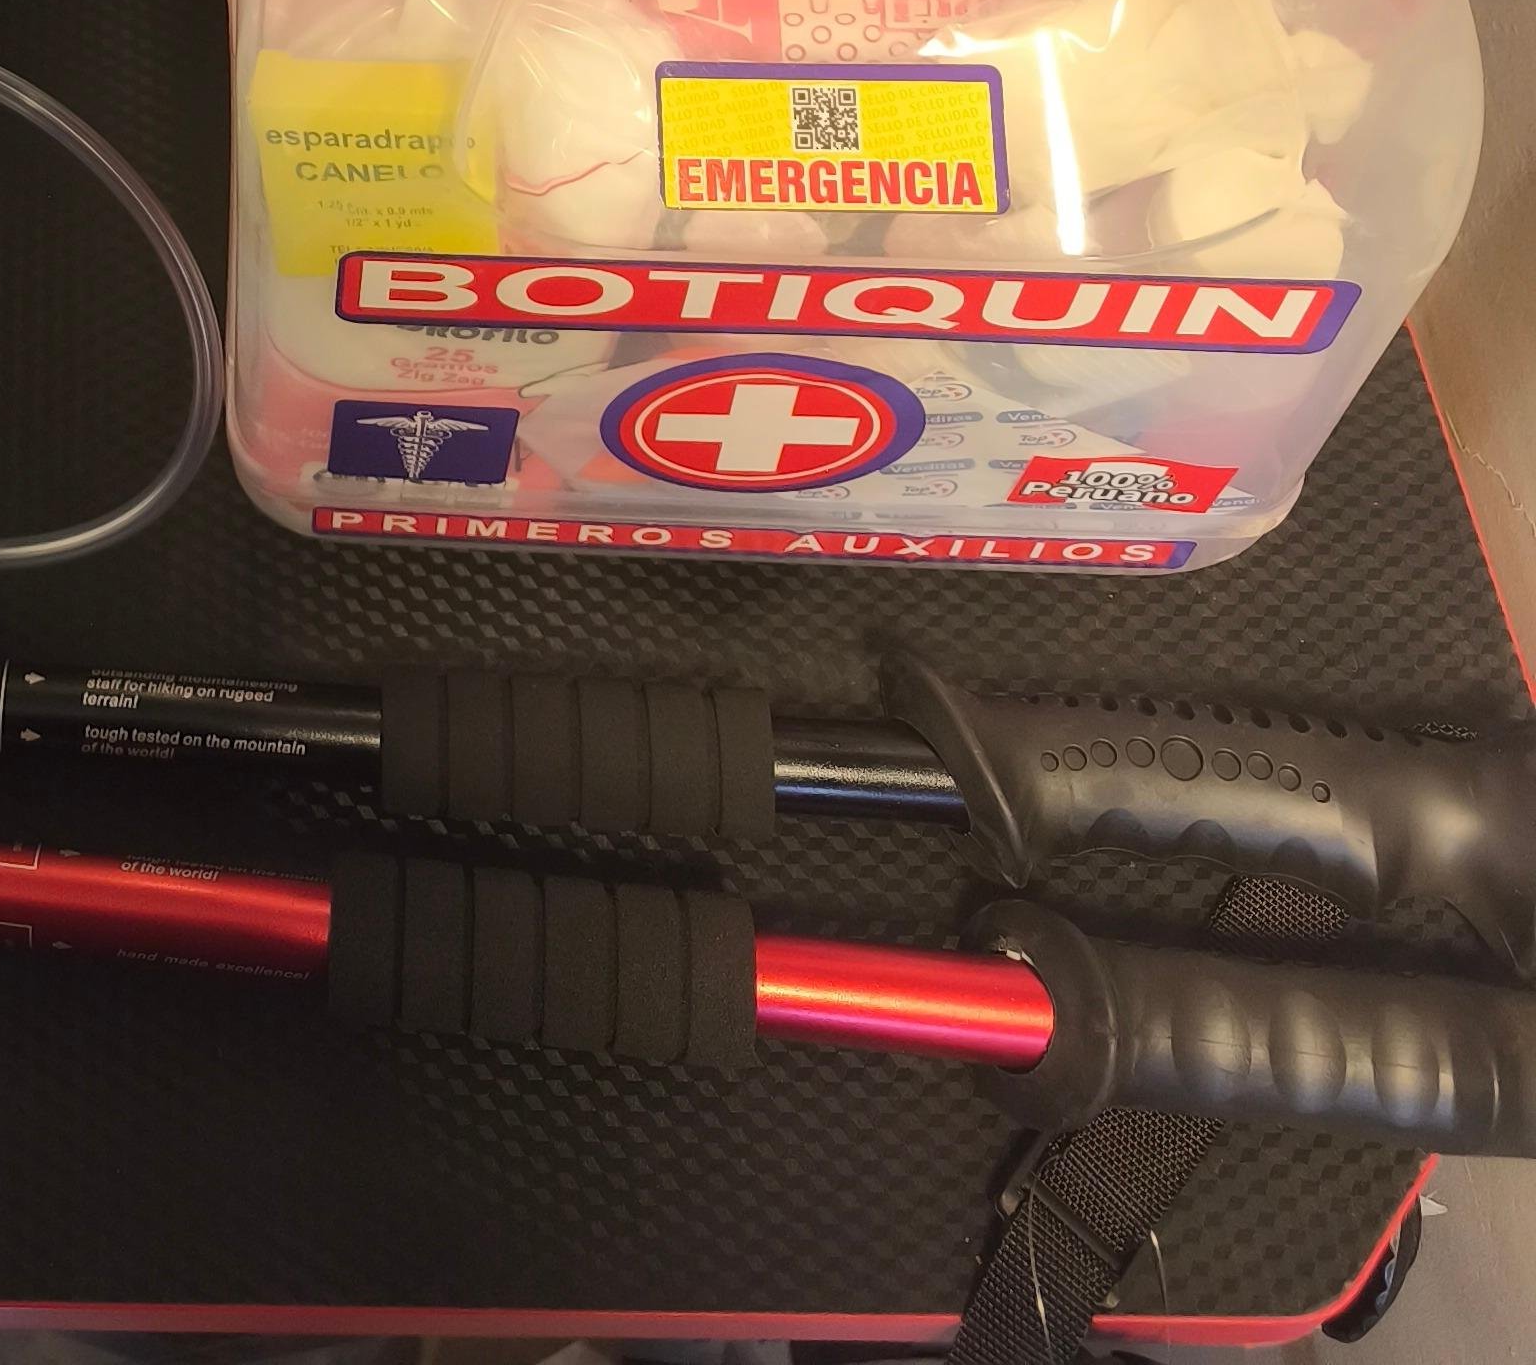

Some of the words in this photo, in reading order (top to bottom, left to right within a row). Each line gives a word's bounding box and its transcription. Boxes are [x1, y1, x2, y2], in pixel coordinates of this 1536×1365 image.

[677, 157, 983, 206] EMERGENCIA
[358, 260, 1323, 339] BOTIQUIN
[390, 356, 499, 375] Gramos
[423, 346, 475, 363] 25
[1058, 469, 1178, 492] 100%
[1020, 481, 1198, 507] Peruano
[329, 511, 734, 548] PRIMEROS
[784, 532, 1158, 563] AUXILIOS
[86, 677, 121, 692] staff
[124, 679, 146, 693] for
[148, 680, 194, 699] hiking
[196, 687, 216, 699] on
[82, 691, 140, 710] terrain!
[81, 741, 98, 756] of
[100, 742, 124, 756] the
[127, 745, 175, 759] world!
[85, 724, 129, 743] tough
[131, 727, 180, 746] tested
[182, 734, 203, 748] on
[206, 733, 231, 750] the
[233, 738, 306, 756] mountain
[120, 860, 139, 872] of
[140, 861, 165, 875] the
[168, 867, 220, 883] world!
[116, 948, 159, 962] hand
[163, 955, 209, 968] made
[215, 962, 312, 981] excellence!
